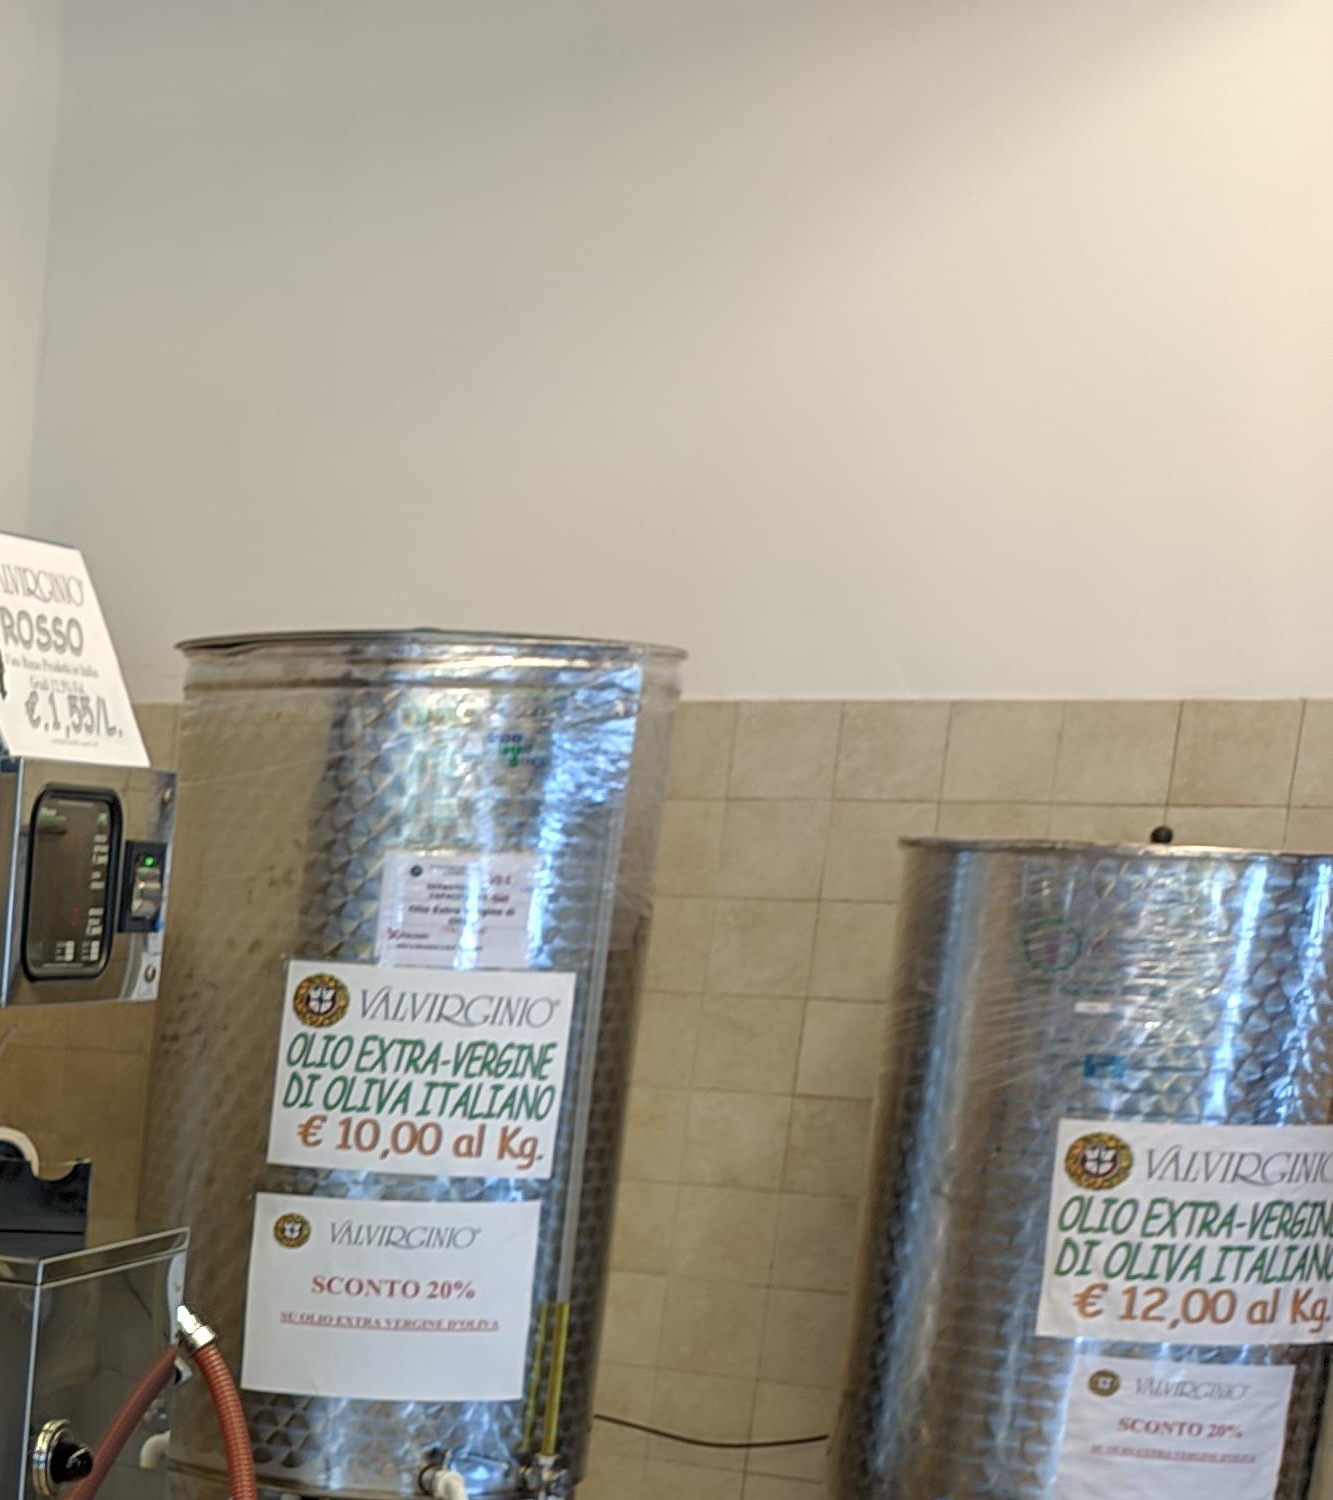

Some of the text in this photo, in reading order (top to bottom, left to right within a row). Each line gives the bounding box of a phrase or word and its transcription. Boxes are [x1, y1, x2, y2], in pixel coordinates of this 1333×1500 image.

[361, 986, 556, 1029] VALVIRGINIO
[286, 1032, 558, 1081] OLIO EXTRA-VERGINE
[283, 1072, 556, 1121] DI OLIVA ITALIANO
[297, 1114, 545, 1170] € 10,00 al Kg.
[330, 1220, 478, 1250] VALVIRGINIO
[1057, 1195, 1138, 1235] OLIO
[1054, 1237, 1101, 1278] DI
[1102, 1240, 1202, 1283] OLIVA
[310, 1275, 477, 1300] SCONTO 20%
[1073, 1282, 1331, 1335] € 12,00 al Kg.
[1117, 1416, 1203, 1438] SCONTO
